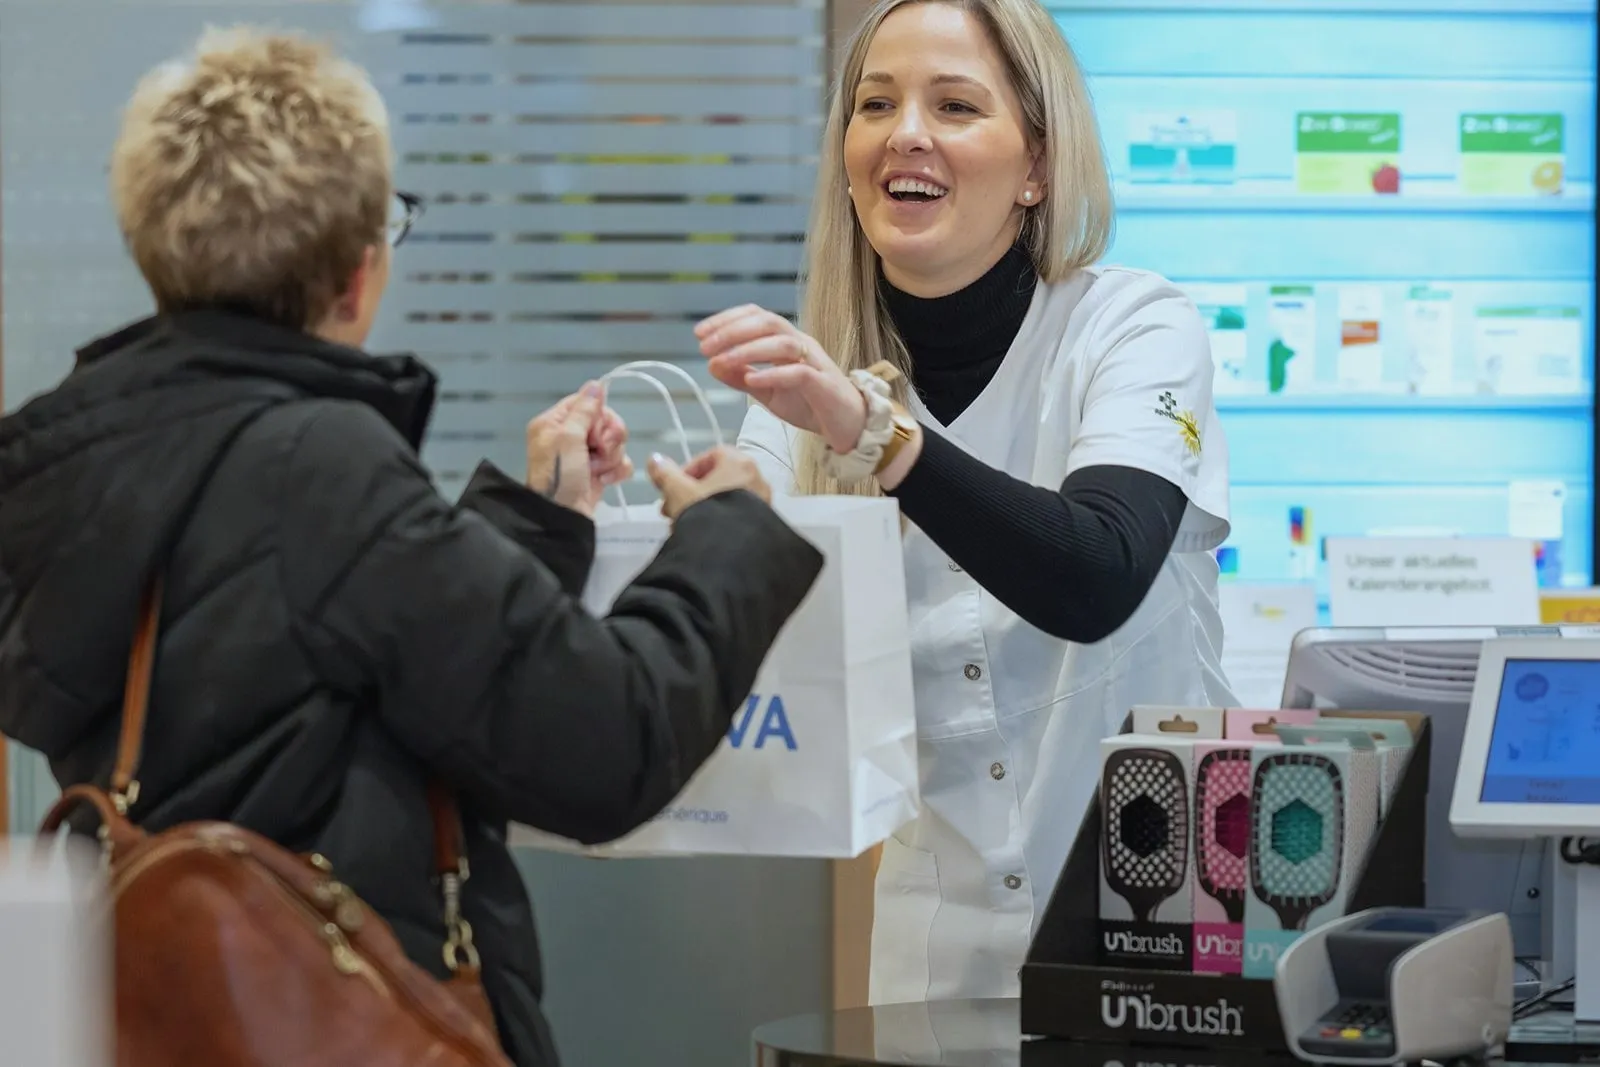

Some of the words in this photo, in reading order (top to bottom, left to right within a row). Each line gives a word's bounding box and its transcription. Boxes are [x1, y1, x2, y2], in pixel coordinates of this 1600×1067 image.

[1345, 552, 1394, 569] Unser
[1403, 553, 1477, 569] aktuelles
[1101, 994, 1244, 1036] unbrush
